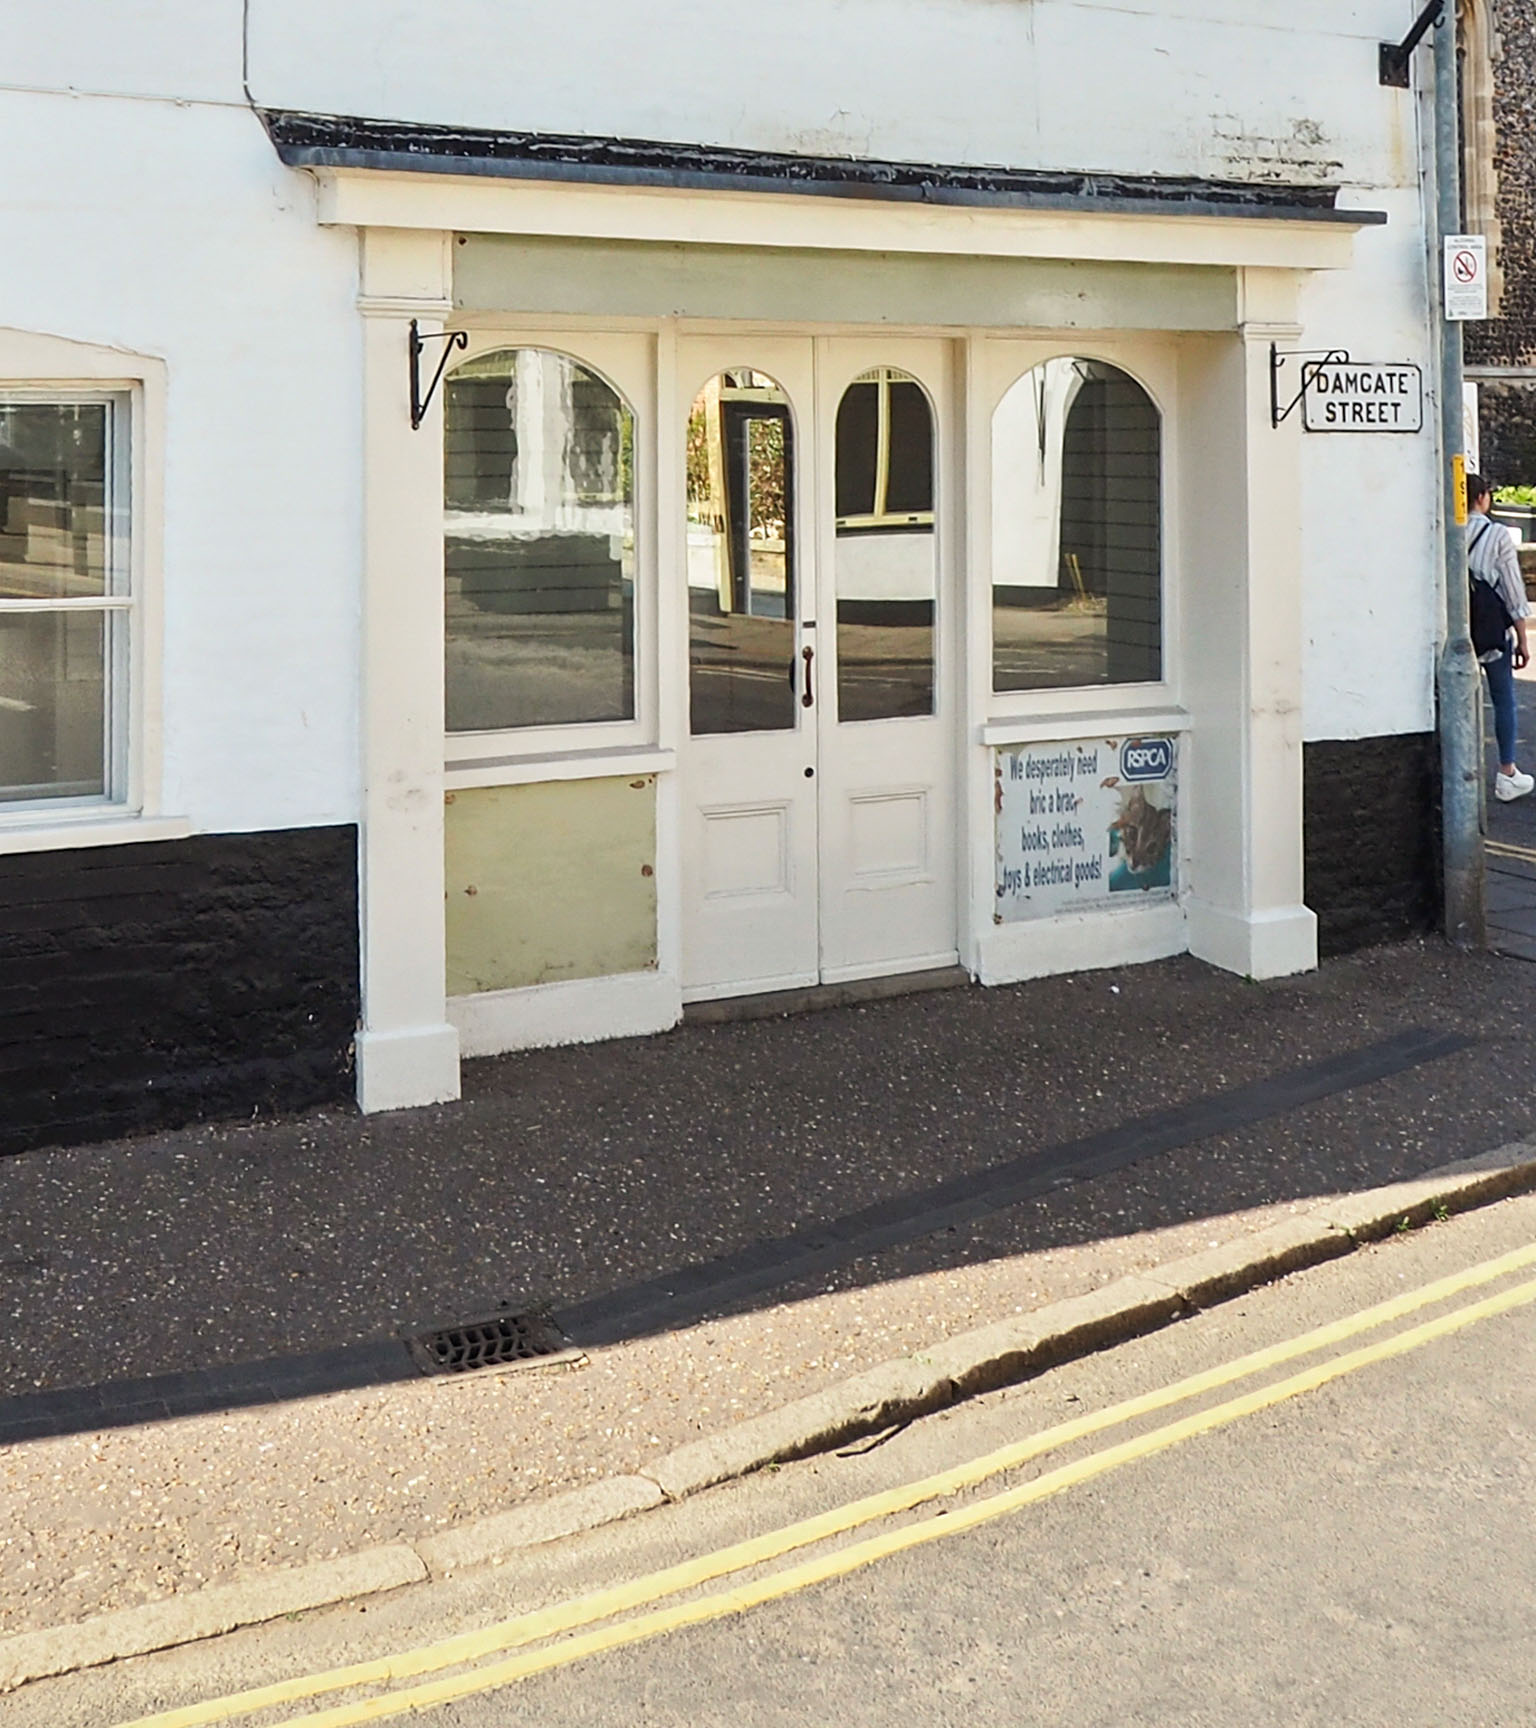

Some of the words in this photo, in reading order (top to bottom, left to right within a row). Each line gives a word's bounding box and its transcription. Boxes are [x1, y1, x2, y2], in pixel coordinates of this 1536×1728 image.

[1325, 402, 1402, 423] STREET
[1010, 755, 1023, 780] We
[1026, 751, 1075, 785] desperately
[1077, 749, 1098, 775] need
[1127, 749, 1166, 768] RSPCA
[1030, 789, 1046, 814] bric
[1048, 794, 1054, 813] a
[1021, 825, 1050, 855] books,
[1051, 822, 1085, 852] clothes,
[1004, 865, 1022, 896] toys
[1024, 861, 1031, 887] &
[1033, 857, 1073, 887] electrical
[1074, 853, 1102, 889] goods!
